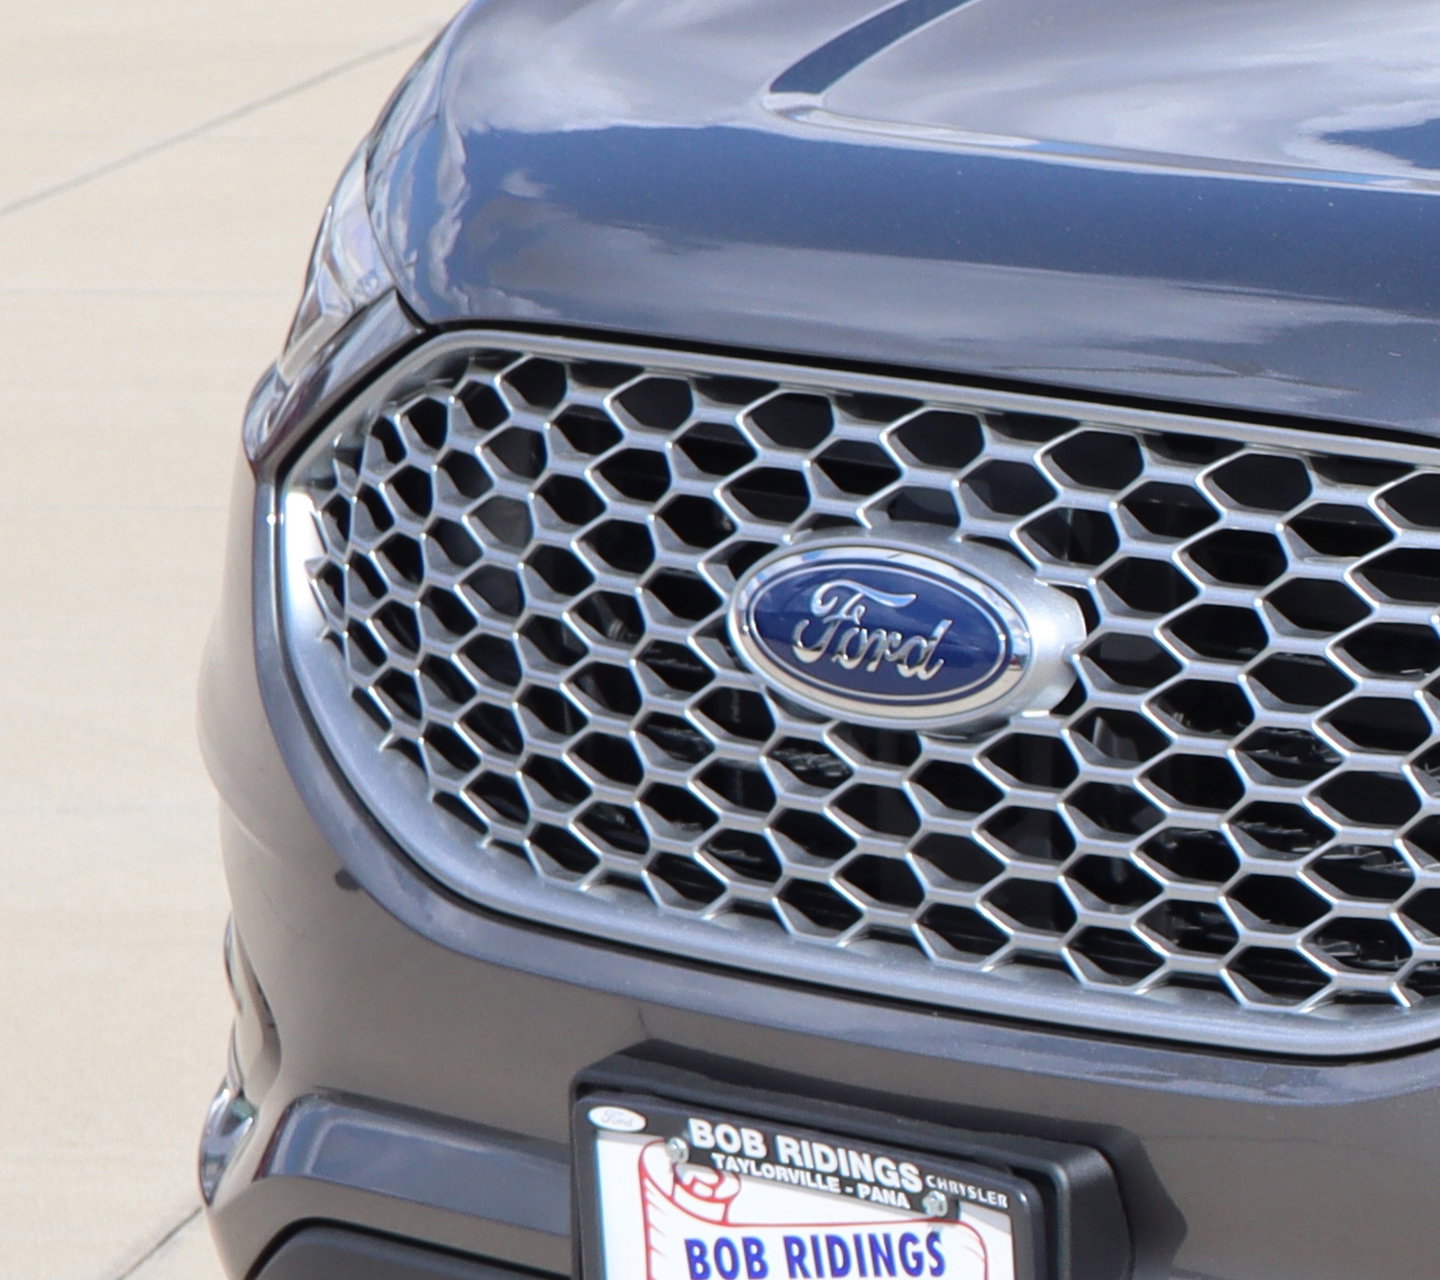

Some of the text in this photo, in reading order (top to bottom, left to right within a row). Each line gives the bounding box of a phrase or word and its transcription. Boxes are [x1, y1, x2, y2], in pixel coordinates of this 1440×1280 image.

[791, 579, 952, 680] Ford
[688, 1117, 923, 1194] BOB RIDINGS
[711, 1152, 841, 1194] TAYLORVILLE
[856, 1183, 911, 1210] PANA
[925, 1174, 1008, 1209] CHRYSLER
[782, 1230, 947, 1279] RIDINGS
